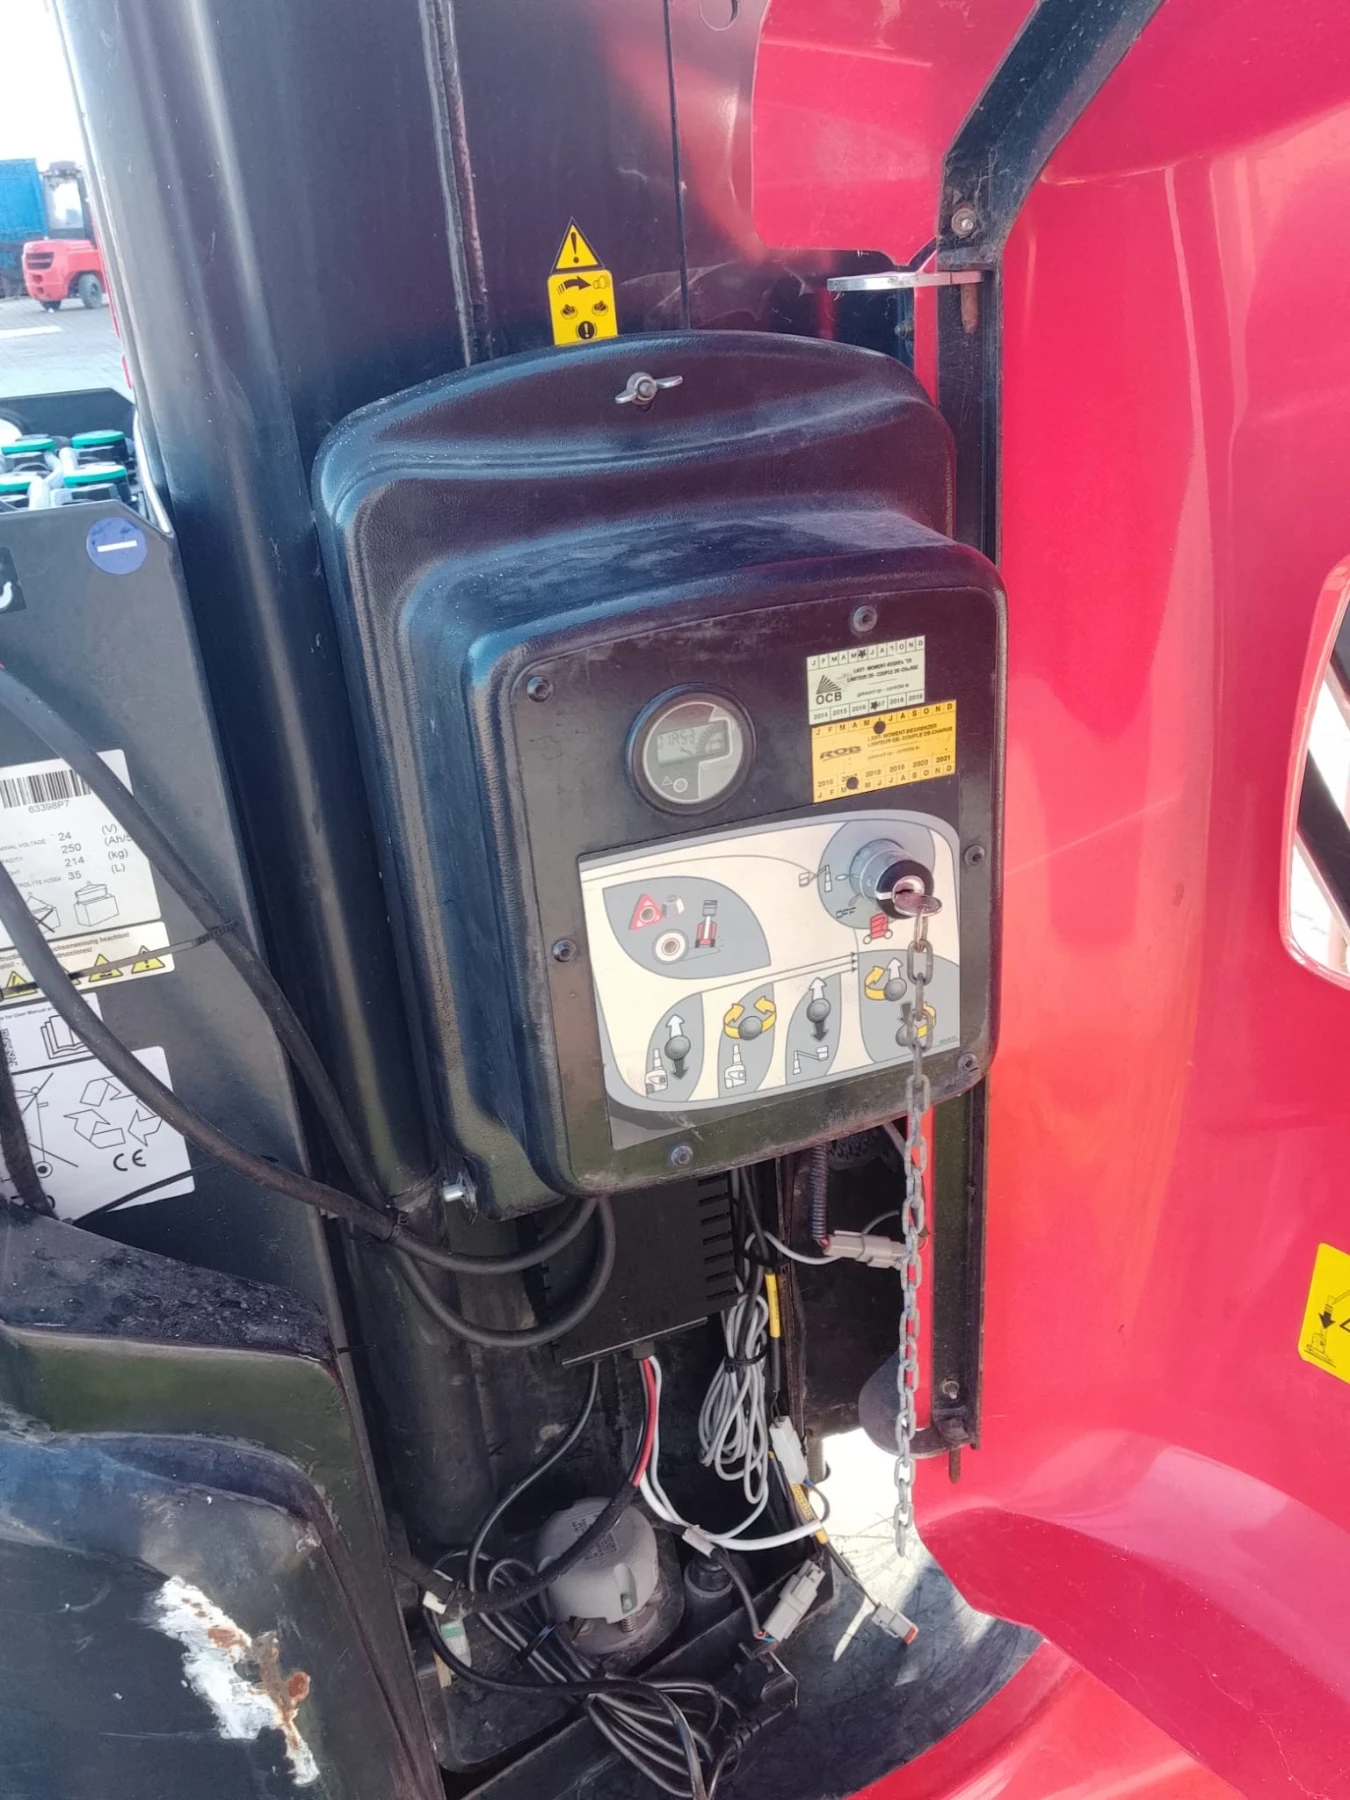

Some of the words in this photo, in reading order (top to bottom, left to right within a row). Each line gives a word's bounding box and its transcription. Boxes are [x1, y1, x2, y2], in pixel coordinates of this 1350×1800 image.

[816, 691, 842, 705] OCB
[832, 708, 847, 716] 2015
[902, 732, 922, 740] COUPLE
[912, 759, 928, 768] 2020
[936, 755, 951, 763] 2021
[28, 800, 70, 814] 63398P7
[18, 839, 47, 848] VOLTAGE
[58, 832, 72, 841] 24
[102, 823, 118, 835] (V)
[61, 843, 82, 854] 250
[64, 857, 85, 868] 214
[108, 848, 128, 860] (kg)
[68, 870, 82, 880] 35
[111, 864, 125, 874] (L)
[113, 1149, 146, 1171] CE
